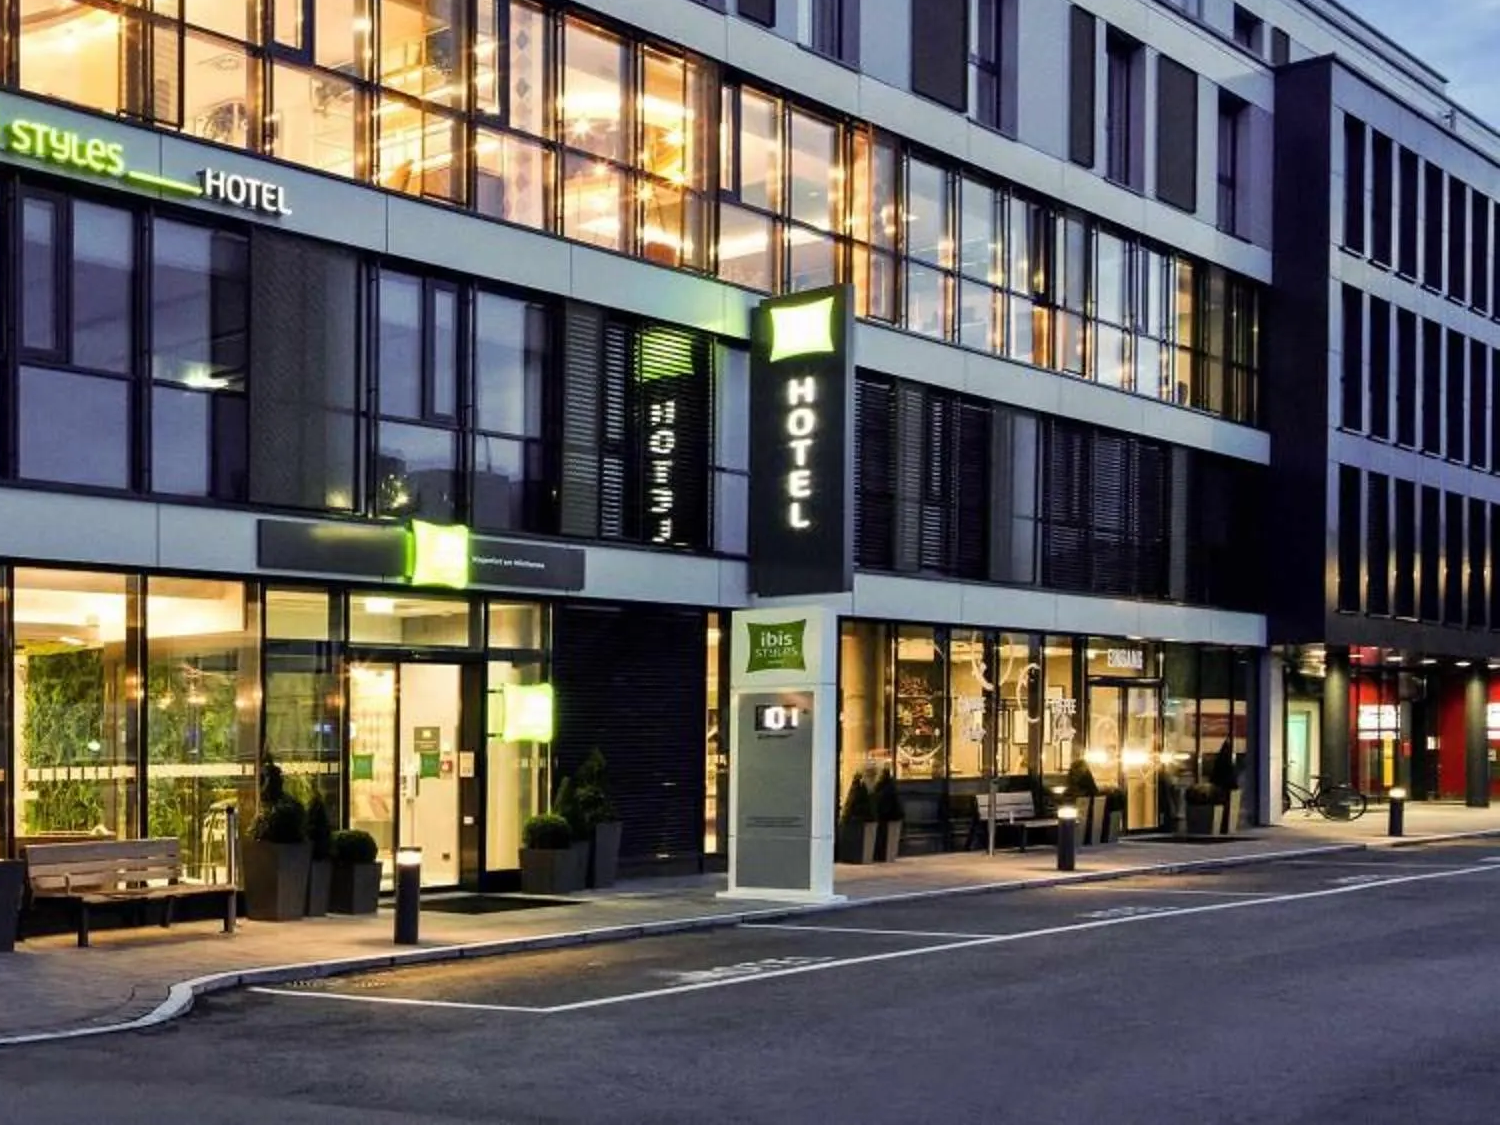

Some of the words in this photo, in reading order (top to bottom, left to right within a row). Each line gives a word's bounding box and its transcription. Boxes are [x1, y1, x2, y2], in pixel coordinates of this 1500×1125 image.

[205, 167, 293, 216] HOTEL
[786, 375, 817, 529] HOTEL
[761, 630, 793, 647] ibis
